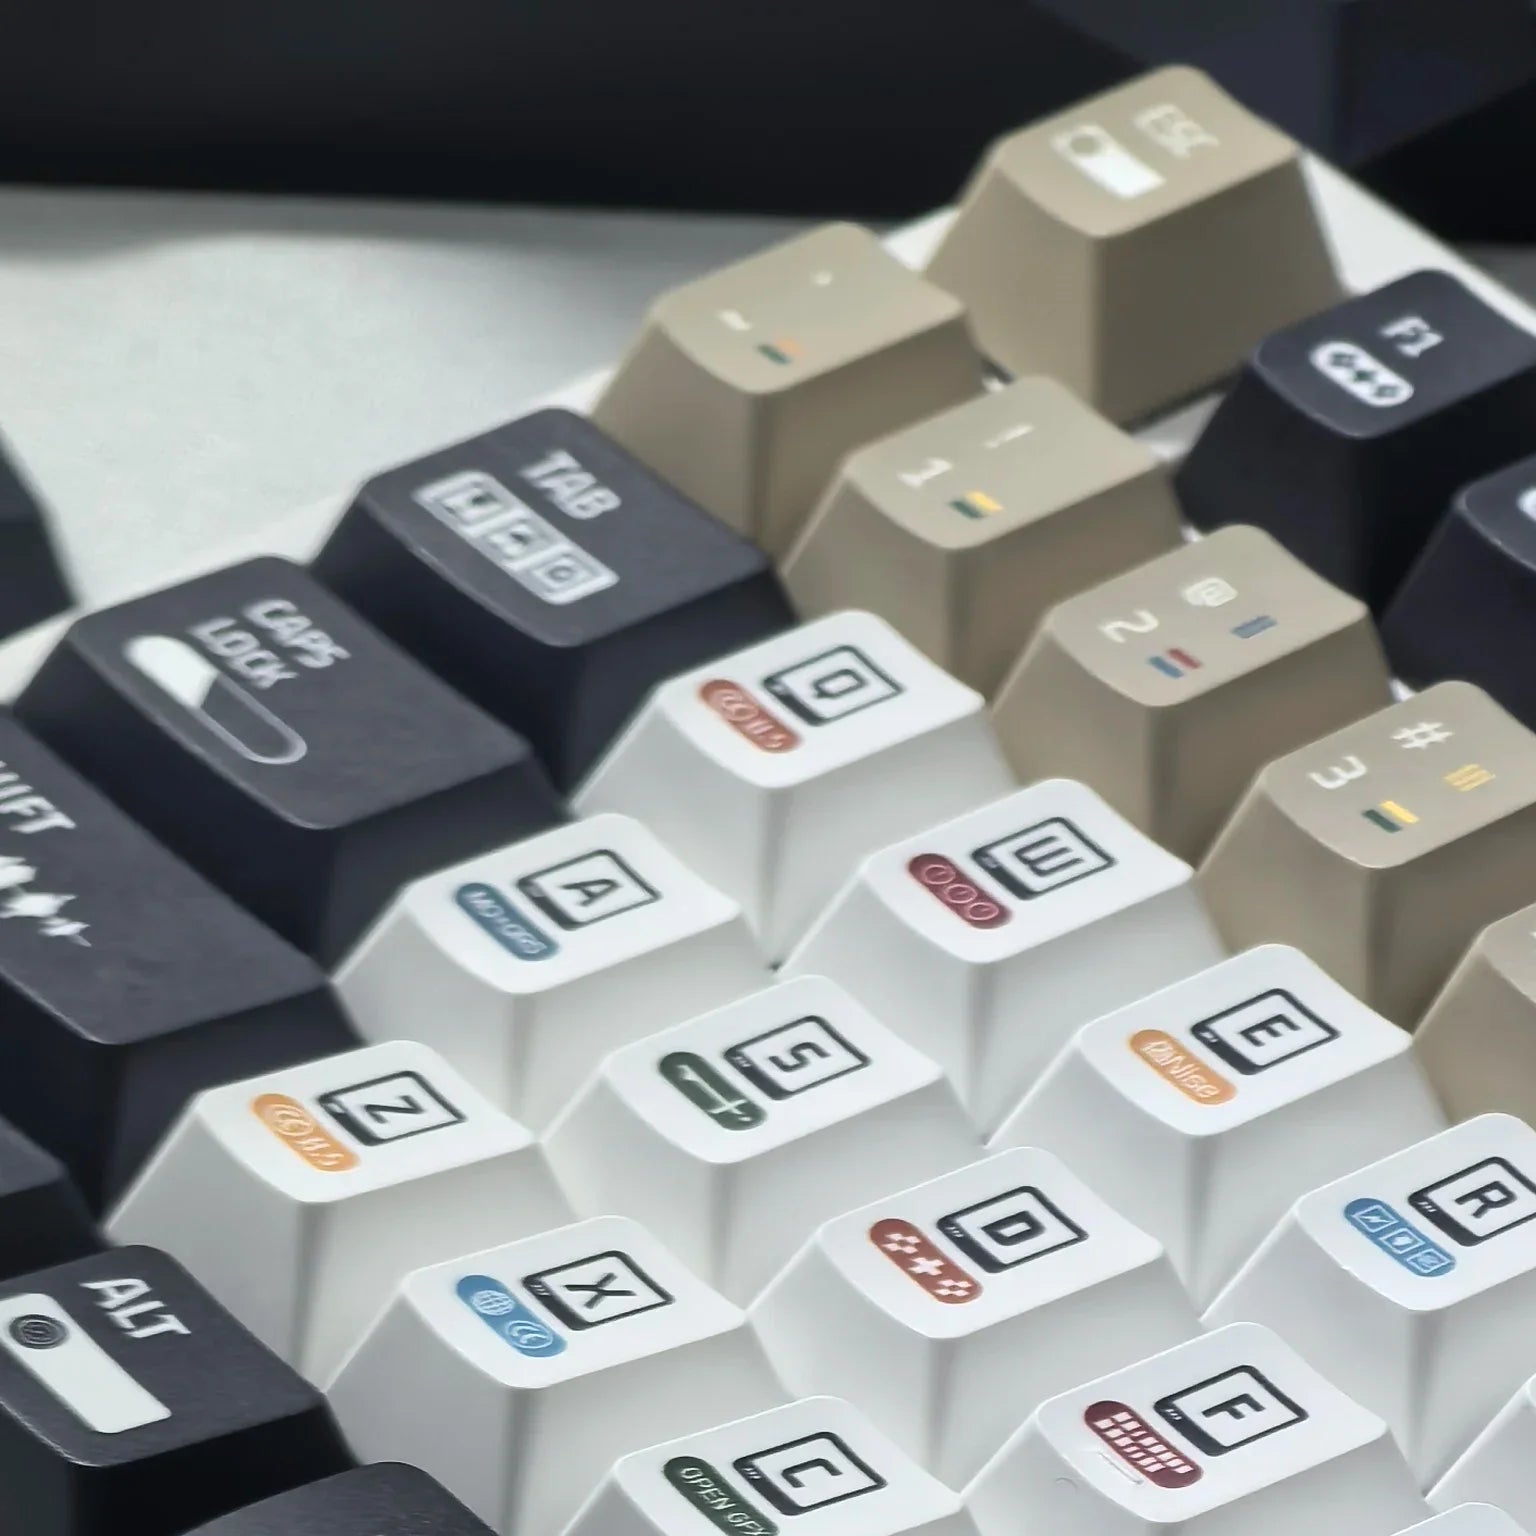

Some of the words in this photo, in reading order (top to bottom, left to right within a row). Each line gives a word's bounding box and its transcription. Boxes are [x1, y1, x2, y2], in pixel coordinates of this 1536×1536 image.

[1383, 317, 1442, 356] F1
[520, 450, 621, 520] TAB
[901, 459, 952, 487] 1
[243, 599, 351, 669] CAPS
[1101, 611, 1158, 642] 2
[188, 617, 298, 689] LOCK
[813, 669, 866, 698] Q
[1393, 723, 1452, 748] #
[1310, 756, 1366, 789] 3
[1014, 836, 1082, 876] W
[562, 879, 619, 906] A
[1239, 1014, 1300, 1046] E
[767, 1041, 831, 1073] S
[364, 1096, 423, 1123] Z
[1455, 1181, 1516, 1218] R
[981, 1210, 1047, 1245] D
[564, 1273, 635, 1308] X
[79, 1278, 191, 1338] ALT
[1202, 1394, 1265, 1419] F
[679, 1467, 736, 1510] OPEN
[781, 1458, 842, 1488] C
